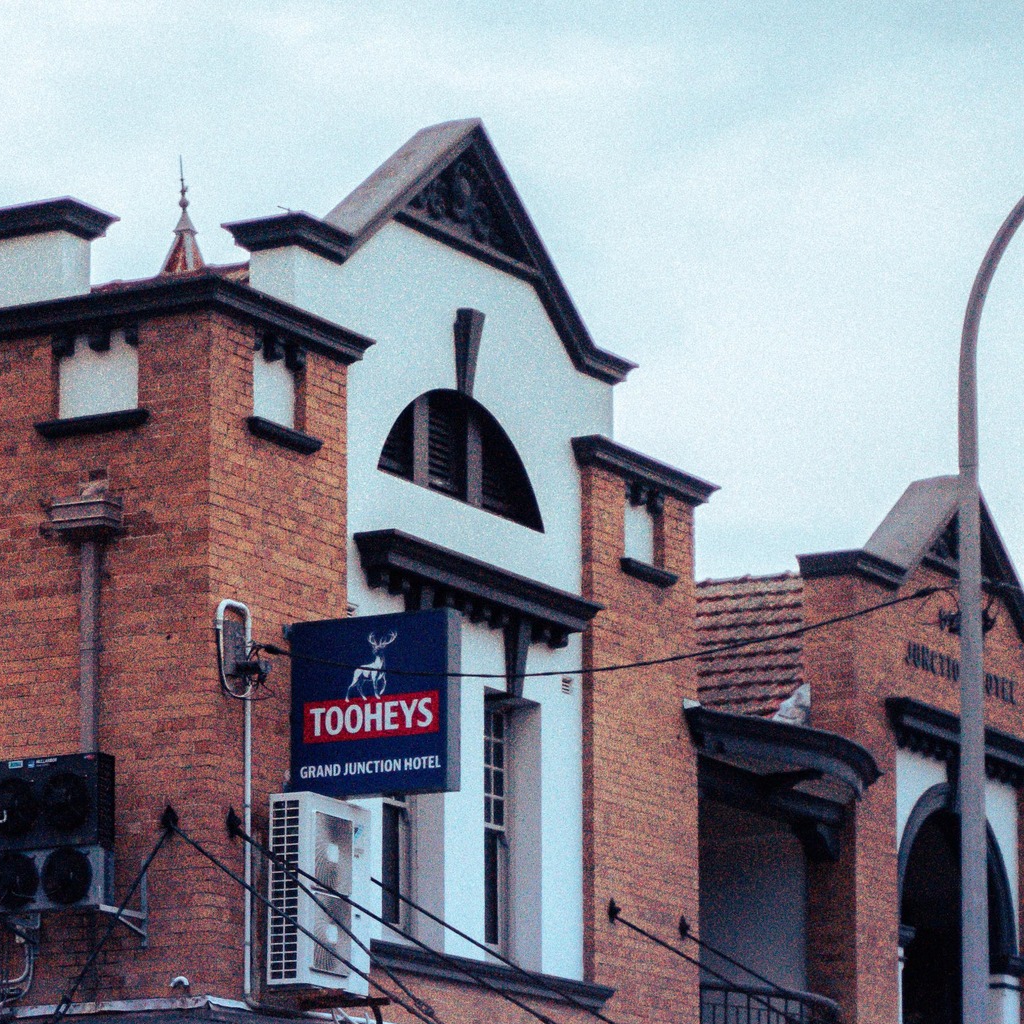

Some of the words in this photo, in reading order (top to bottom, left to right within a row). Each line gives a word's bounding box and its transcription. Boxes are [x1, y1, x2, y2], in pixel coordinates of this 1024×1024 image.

[904, 641, 959, 682] JUNCTIO
[310, 697, 434, 737] TOOHEYS
[300, 764, 341, 779] GRAND
[343, 759, 402, 776] JUNCTION
[404, 755, 441, 770] HOTEL
